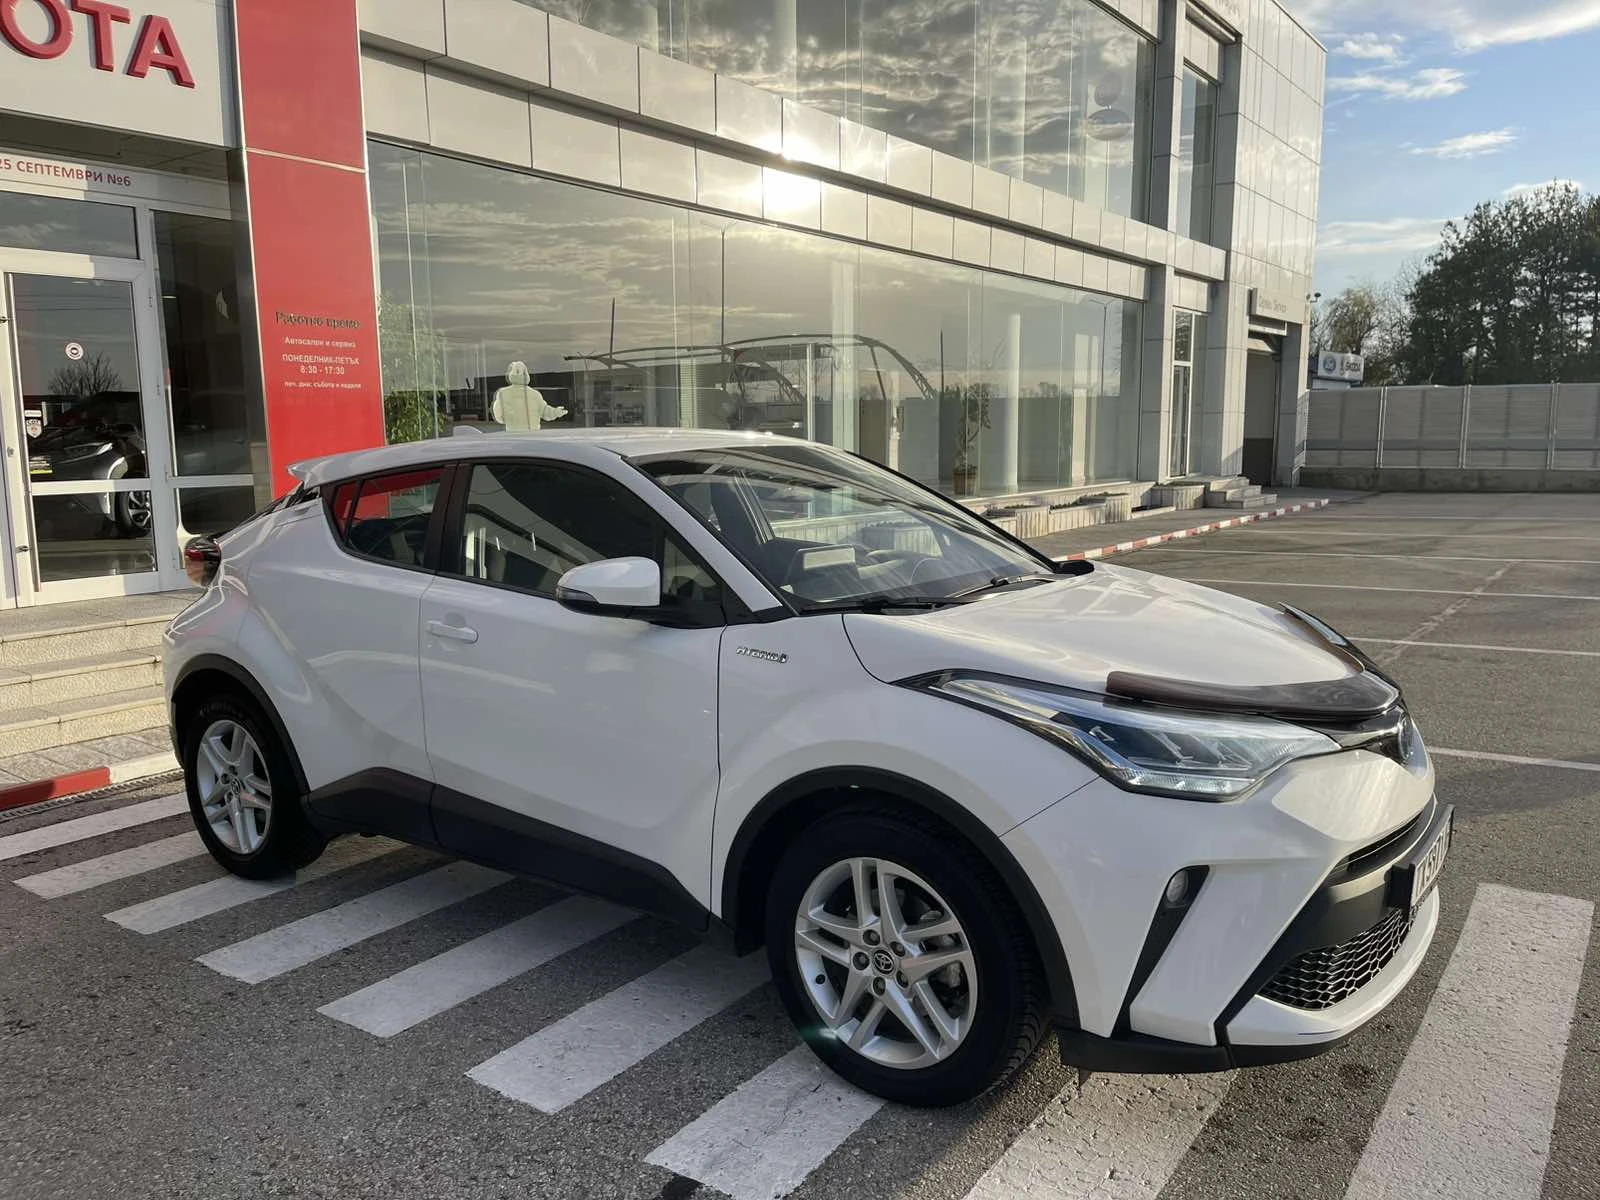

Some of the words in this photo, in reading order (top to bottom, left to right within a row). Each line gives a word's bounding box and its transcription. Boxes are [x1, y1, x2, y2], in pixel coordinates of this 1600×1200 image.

[16, 160, 103, 183] СЕПТЕМВРИ
[107, 174, 131, 186] №6
[324, 366, 345, 375] 17:30
